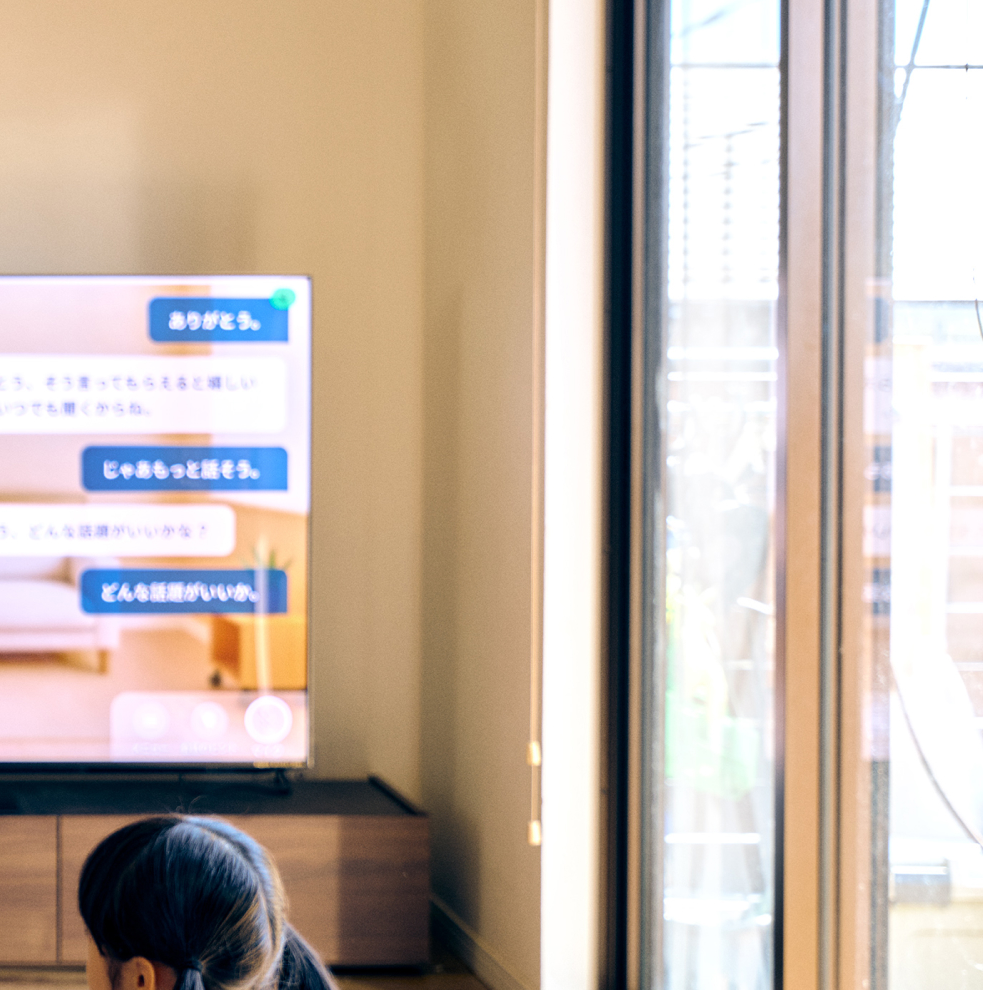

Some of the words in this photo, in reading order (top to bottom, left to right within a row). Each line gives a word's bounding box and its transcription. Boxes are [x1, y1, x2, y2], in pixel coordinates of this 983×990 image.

[168, 309, 262, 332] ありがとう。
[102, 458, 261, 481] じゃあもっと話そう。
